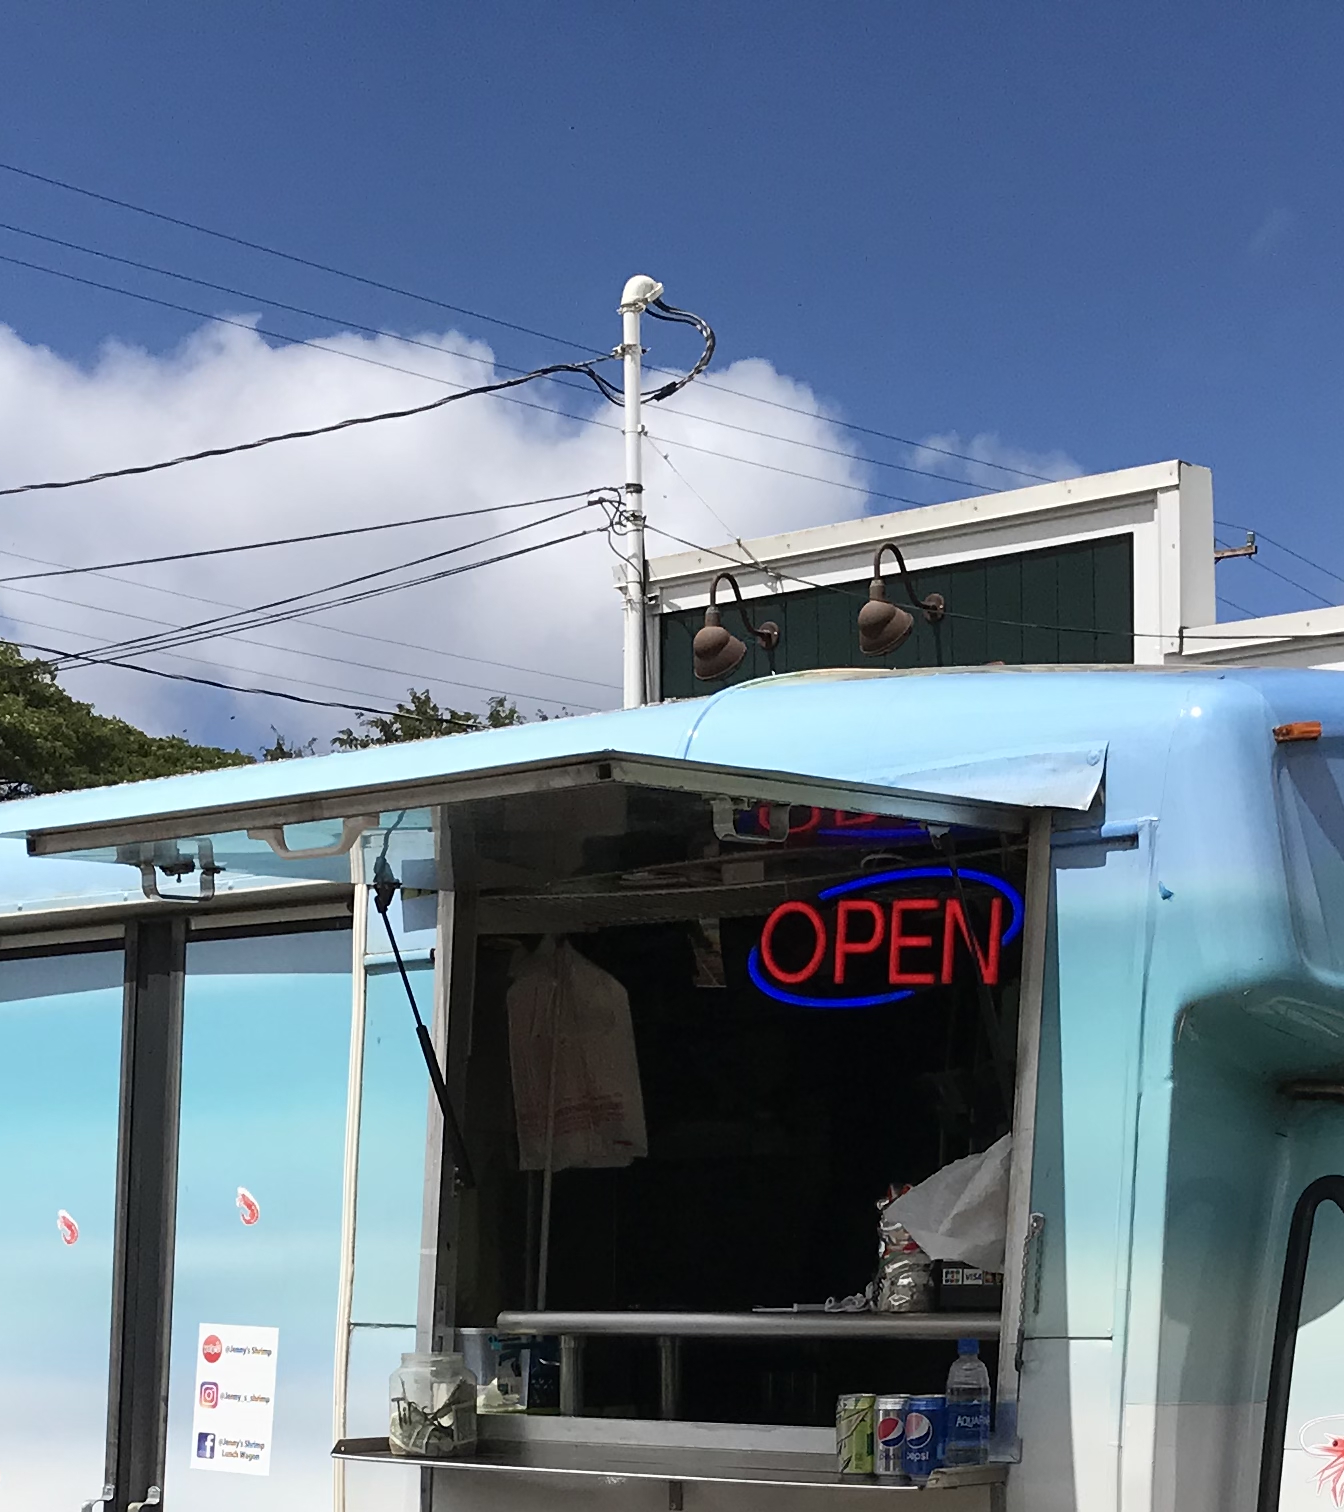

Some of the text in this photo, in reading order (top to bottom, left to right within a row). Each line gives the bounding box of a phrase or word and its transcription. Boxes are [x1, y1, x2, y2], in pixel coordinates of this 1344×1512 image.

[761, 898, 1002, 985] OPEN
[251, 1346, 272, 1357] Shrimp
[244, 1440, 265, 1452] Shrimp
[221, 1450, 260, 1462] Lunch Wagon
